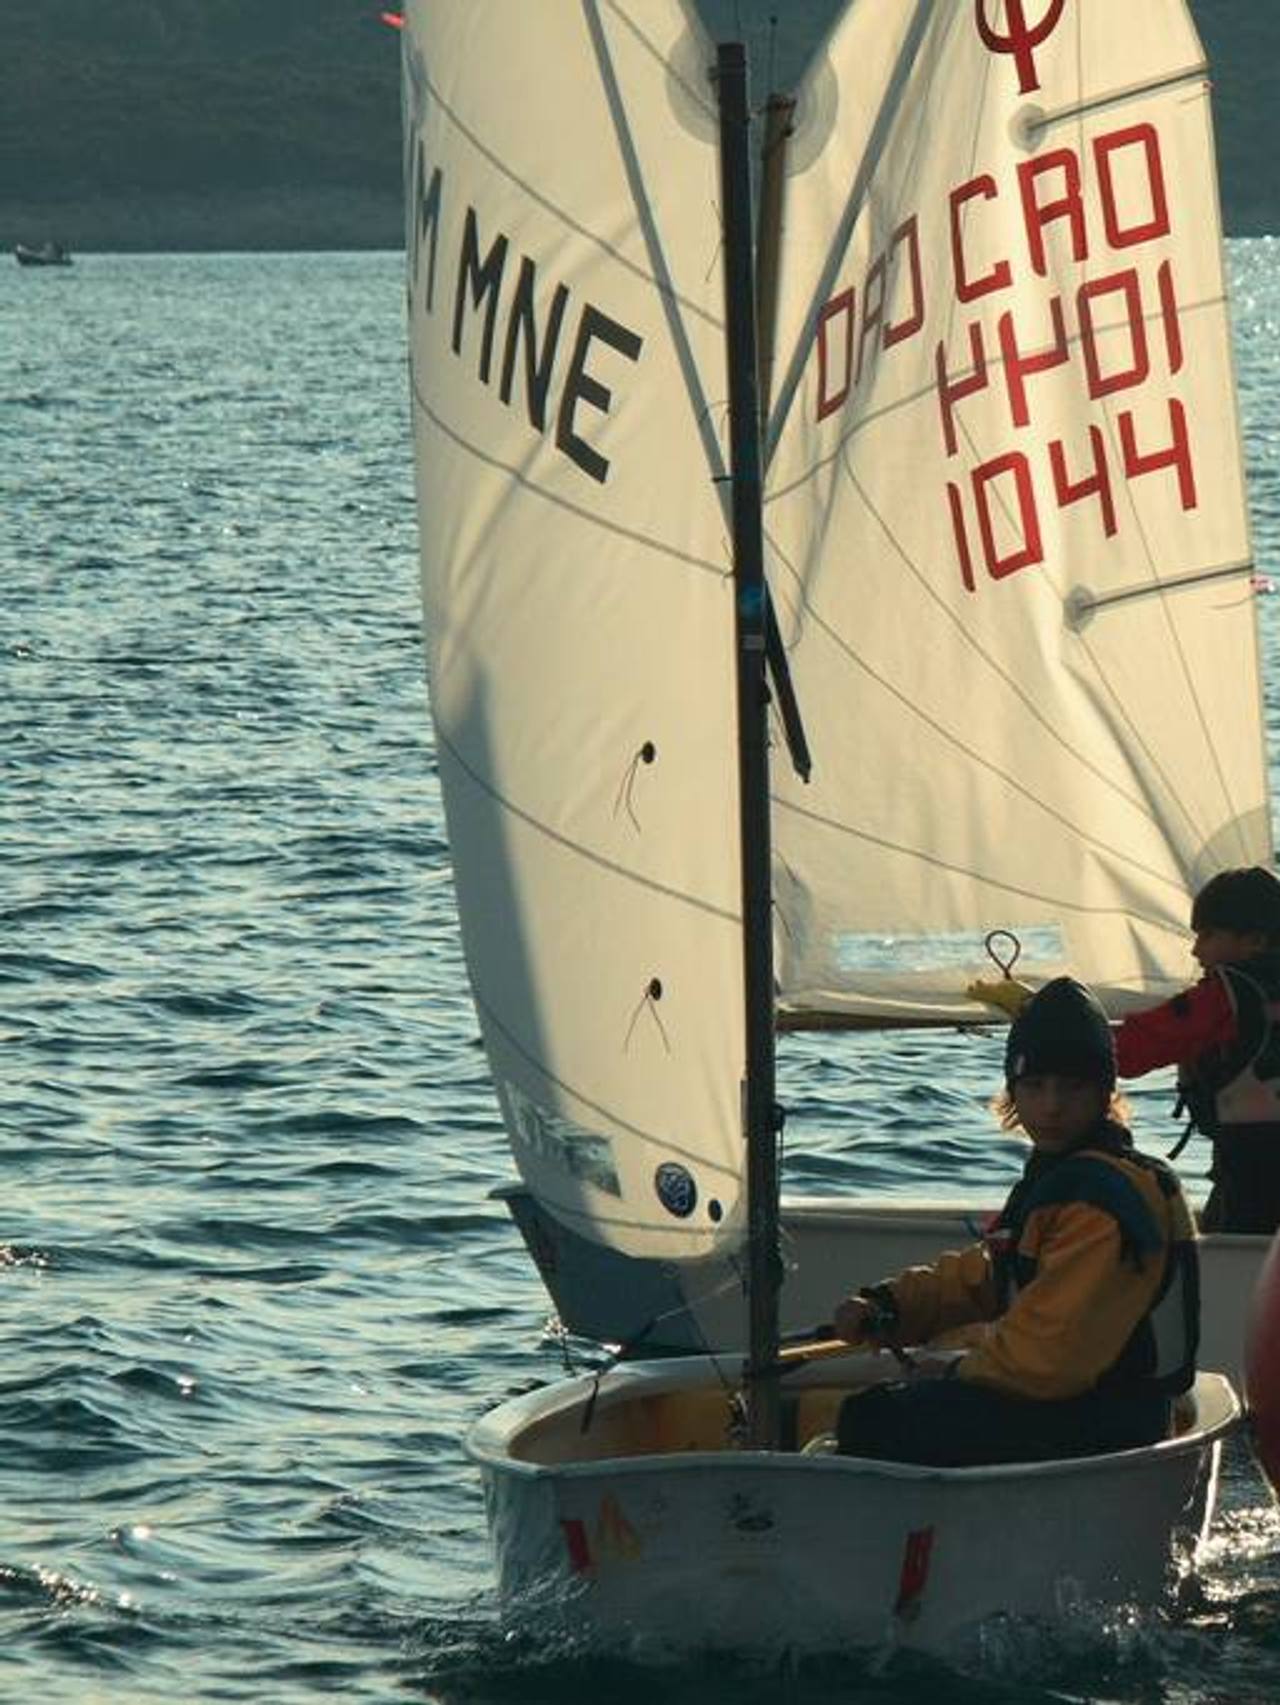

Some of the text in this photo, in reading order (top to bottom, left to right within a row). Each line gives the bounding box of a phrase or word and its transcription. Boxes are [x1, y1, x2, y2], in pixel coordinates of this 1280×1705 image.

[949, 122, 1171, 304] CRO
[452, 205, 645, 484] MNE
[946, 397, 1197, 592] 1044
